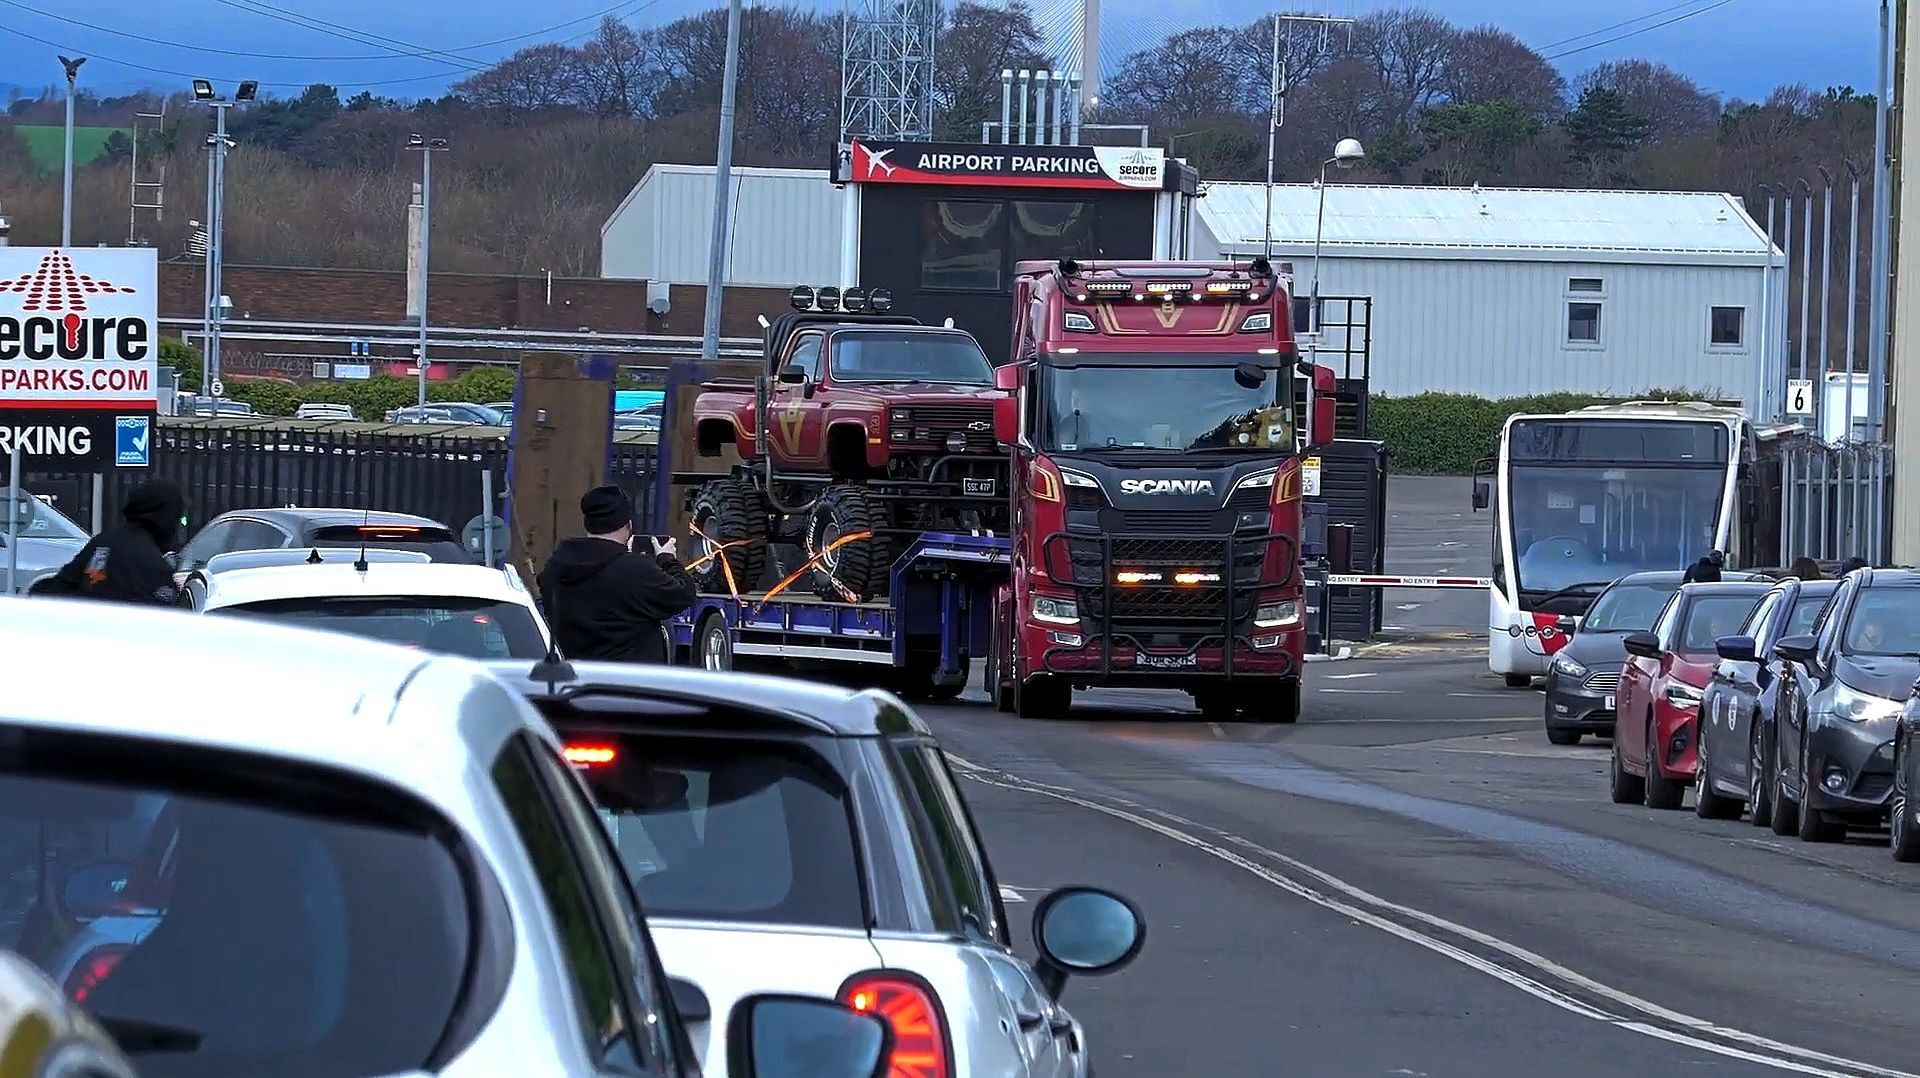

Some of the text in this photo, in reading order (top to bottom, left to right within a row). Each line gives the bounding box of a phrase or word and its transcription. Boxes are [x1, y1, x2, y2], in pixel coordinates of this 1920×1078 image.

[917, 153, 1099, 174] AIRPORT PARKING
[0, 314, 148, 361] ecure
[1, 369, 148, 391] PARKS.COM
[1795, 388, 1804, 411] 6
[0, 426, 91, 455] RKING
[1120, 480, 1215, 495] SCANIA
